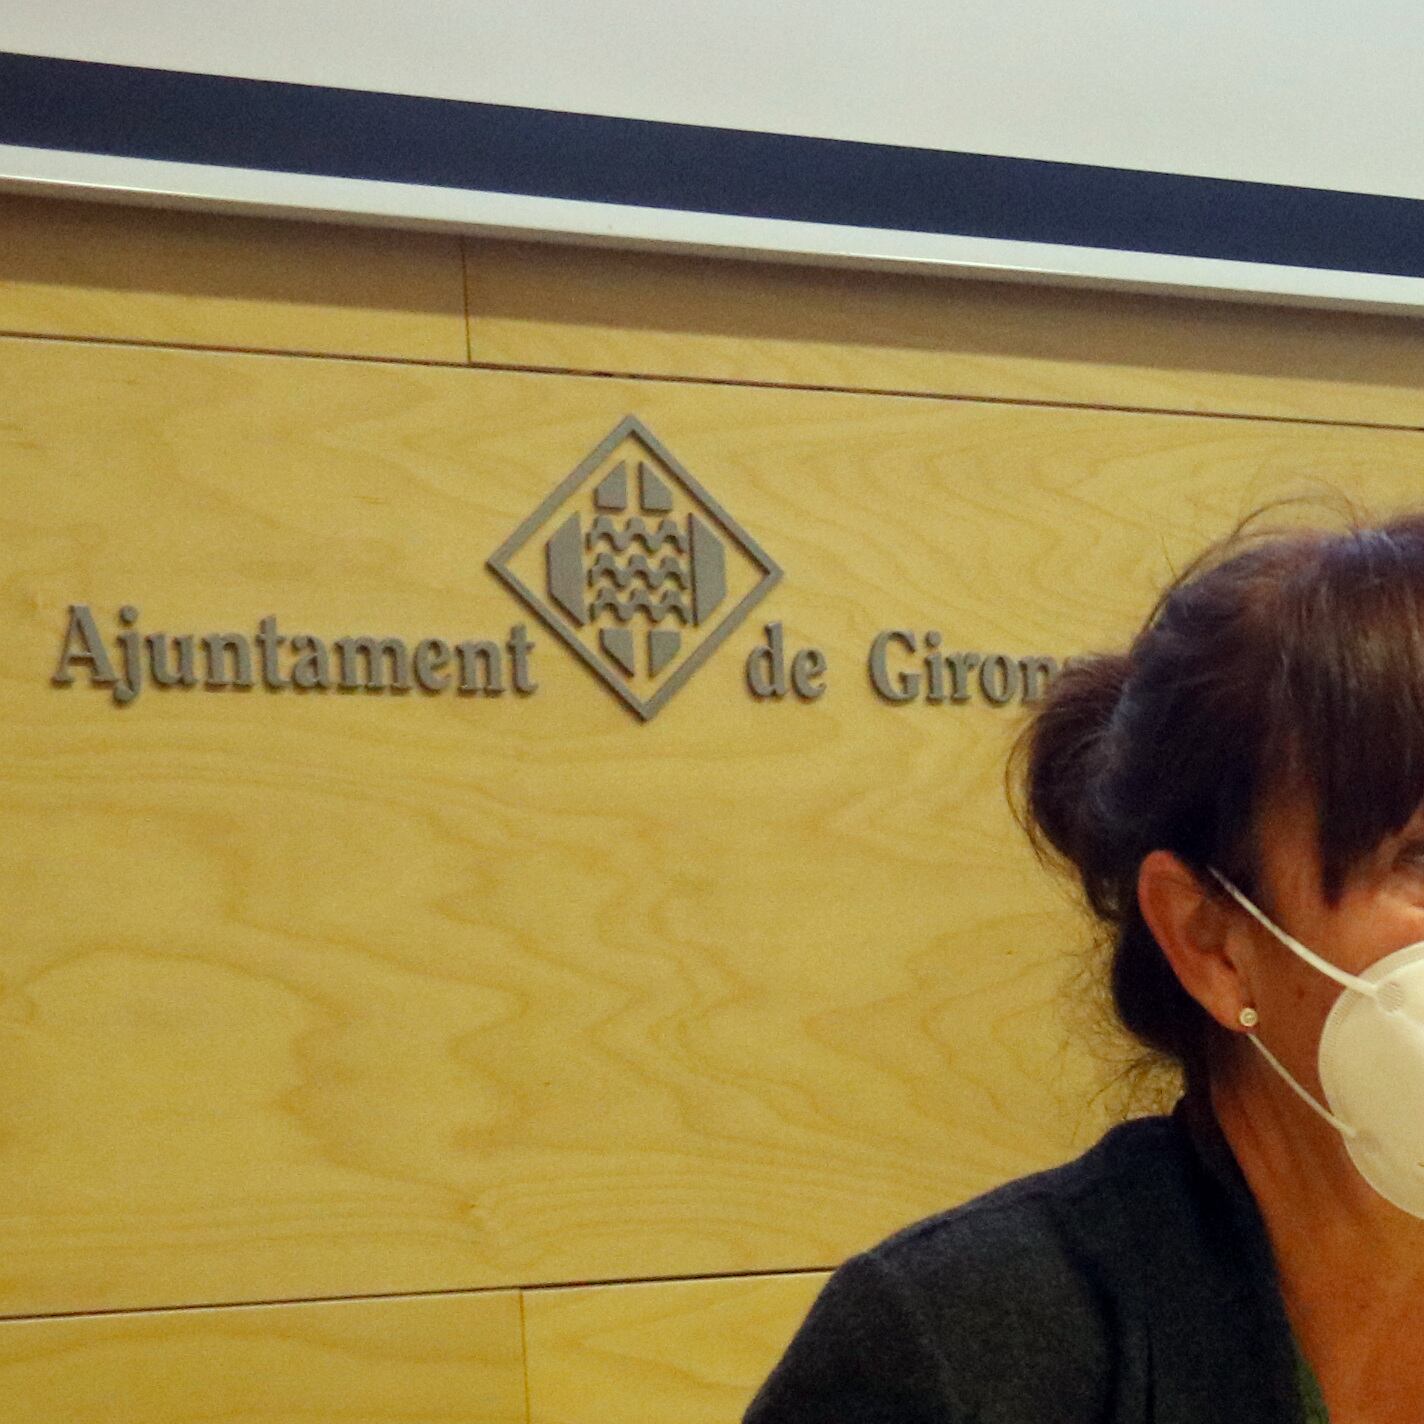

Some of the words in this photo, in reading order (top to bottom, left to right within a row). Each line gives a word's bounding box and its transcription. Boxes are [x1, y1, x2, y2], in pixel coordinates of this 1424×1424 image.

[52, 604, 538, 706] Ajuntament
[747, 622, 826, 702] de
[868, 629, 1088, 706] Giron
